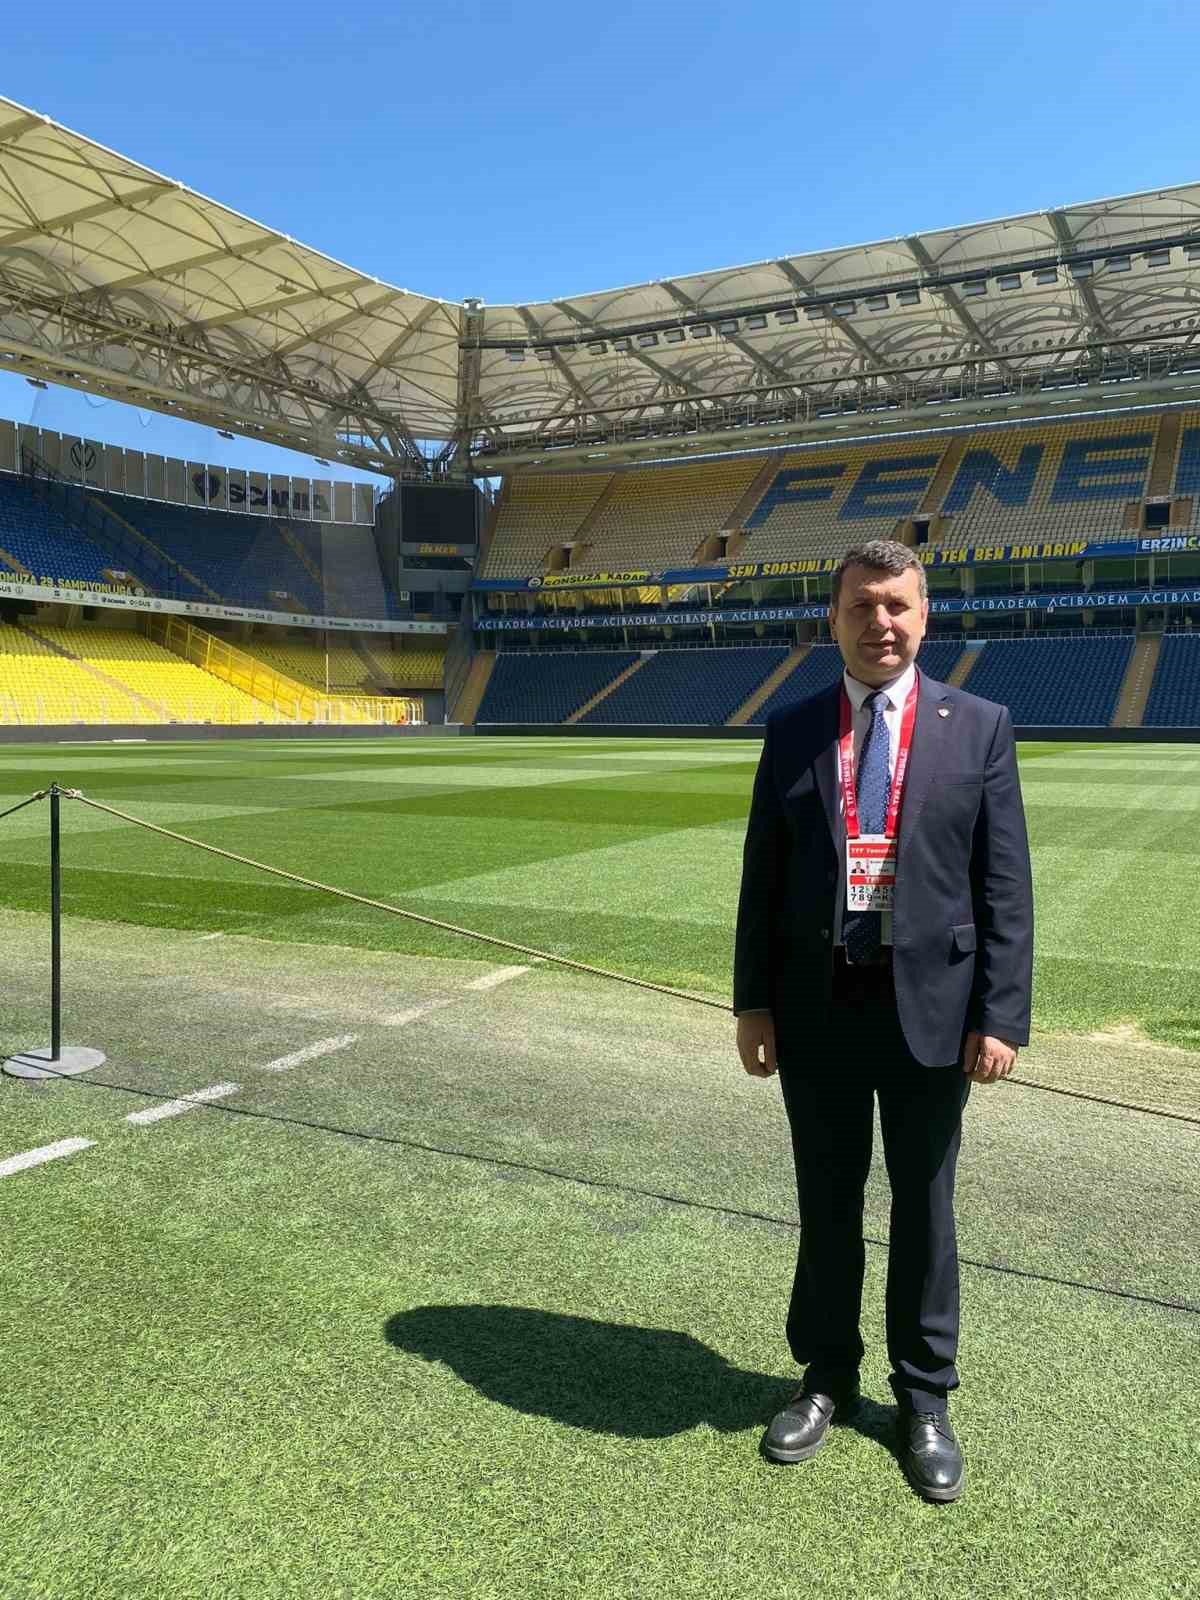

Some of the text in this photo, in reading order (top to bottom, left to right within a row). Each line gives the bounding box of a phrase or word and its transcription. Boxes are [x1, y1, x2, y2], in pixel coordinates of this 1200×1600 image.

[1141, 536, 1200, 550] ERZINC
[917, 551, 935, 565] IR
[973, 547, 1004, 561] BEN
[478, 620, 534, 630] ACIBADEM
[542, 618, 594, 629] ACIBADEM
[602, 616, 657, 626] ACIBADEM
[665, 612, 723, 624] ACIBADEM
[731, 609, 794, 622] ACIBADEM
[928, 601, 950, 611] EM
[962, 599, 1038, 610] ACIBADEM
[1048, 595, 1129, 607] ACIBADEM
